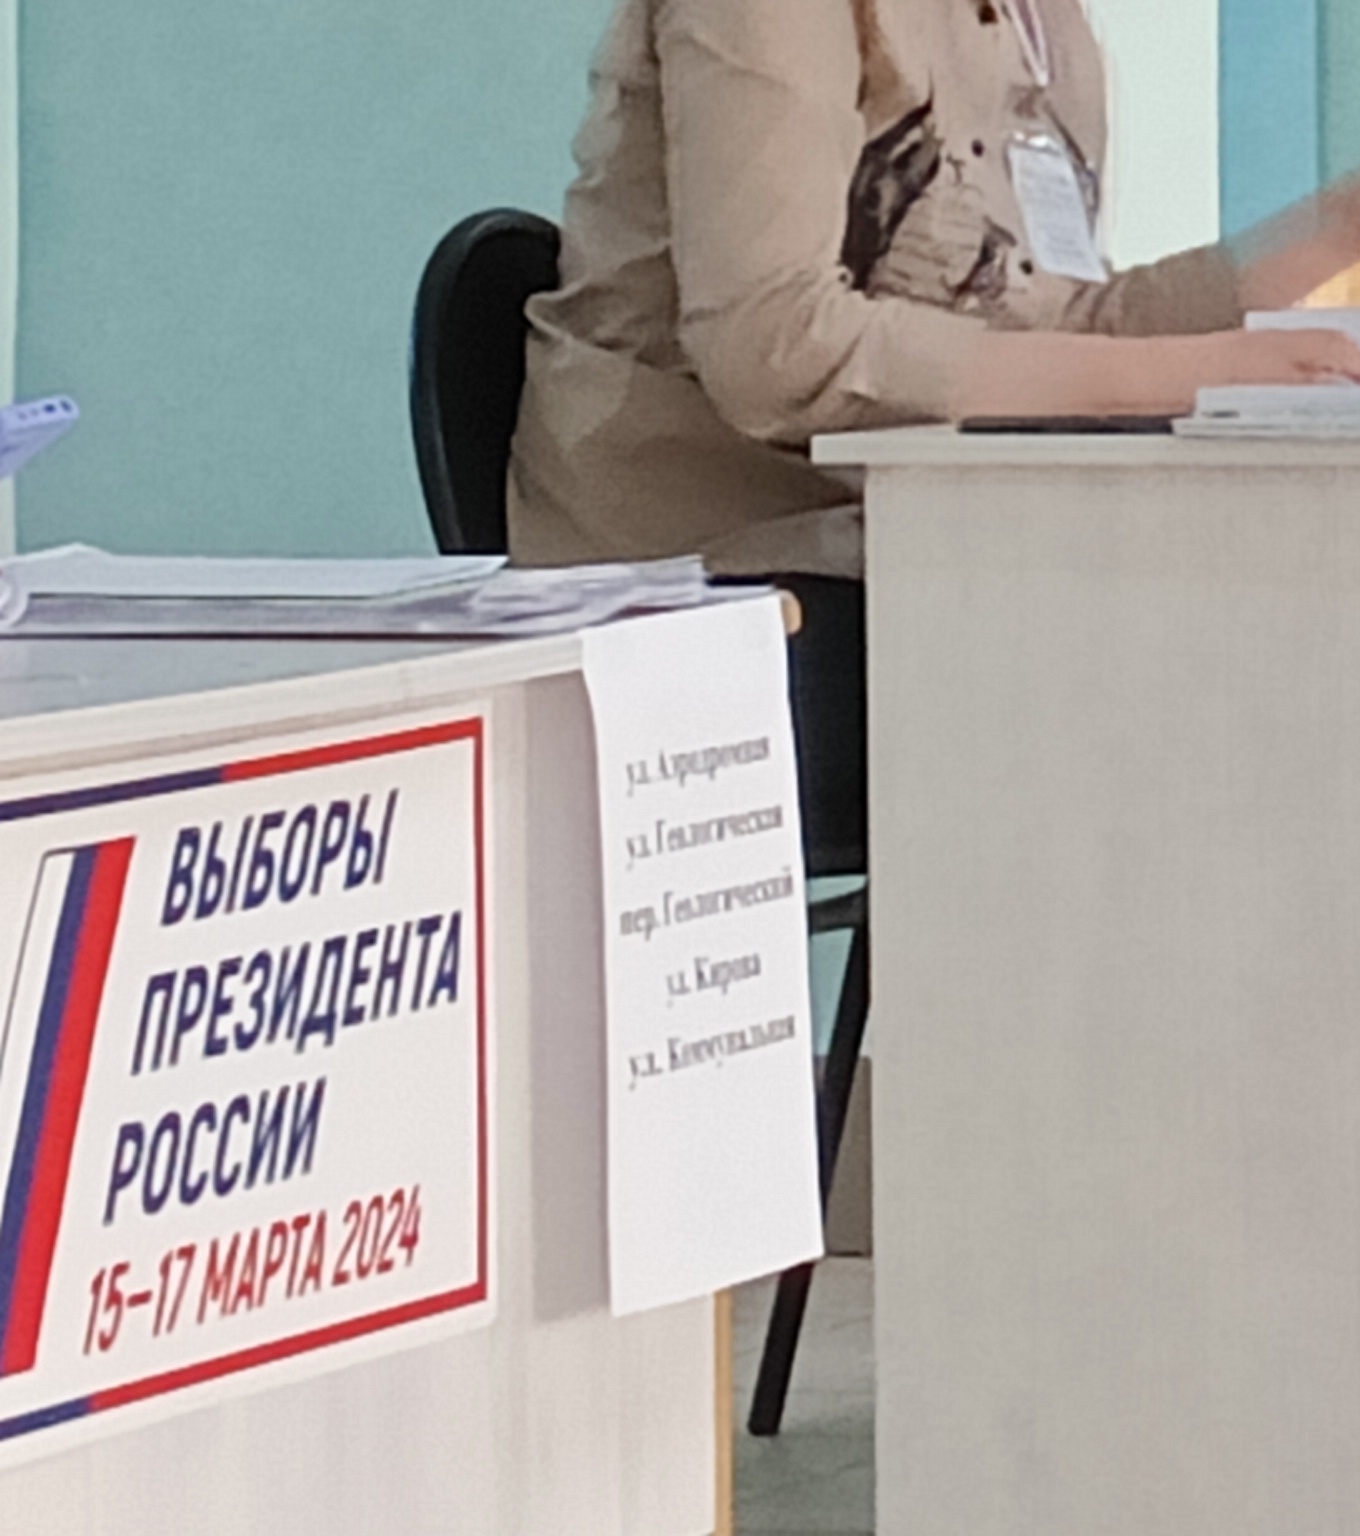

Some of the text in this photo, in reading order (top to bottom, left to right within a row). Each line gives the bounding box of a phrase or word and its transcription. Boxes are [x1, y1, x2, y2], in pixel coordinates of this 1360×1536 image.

[161, 788, 398, 926] ВЫБОРЫ
[131, 911, 462, 1076] ПРЕЗИДЕНТА
[104, 1077, 327, 1225] РОССИИ
[198, 1210, 329, 1323] МАРТА
[333, 1185, 421, 1287] 2024
